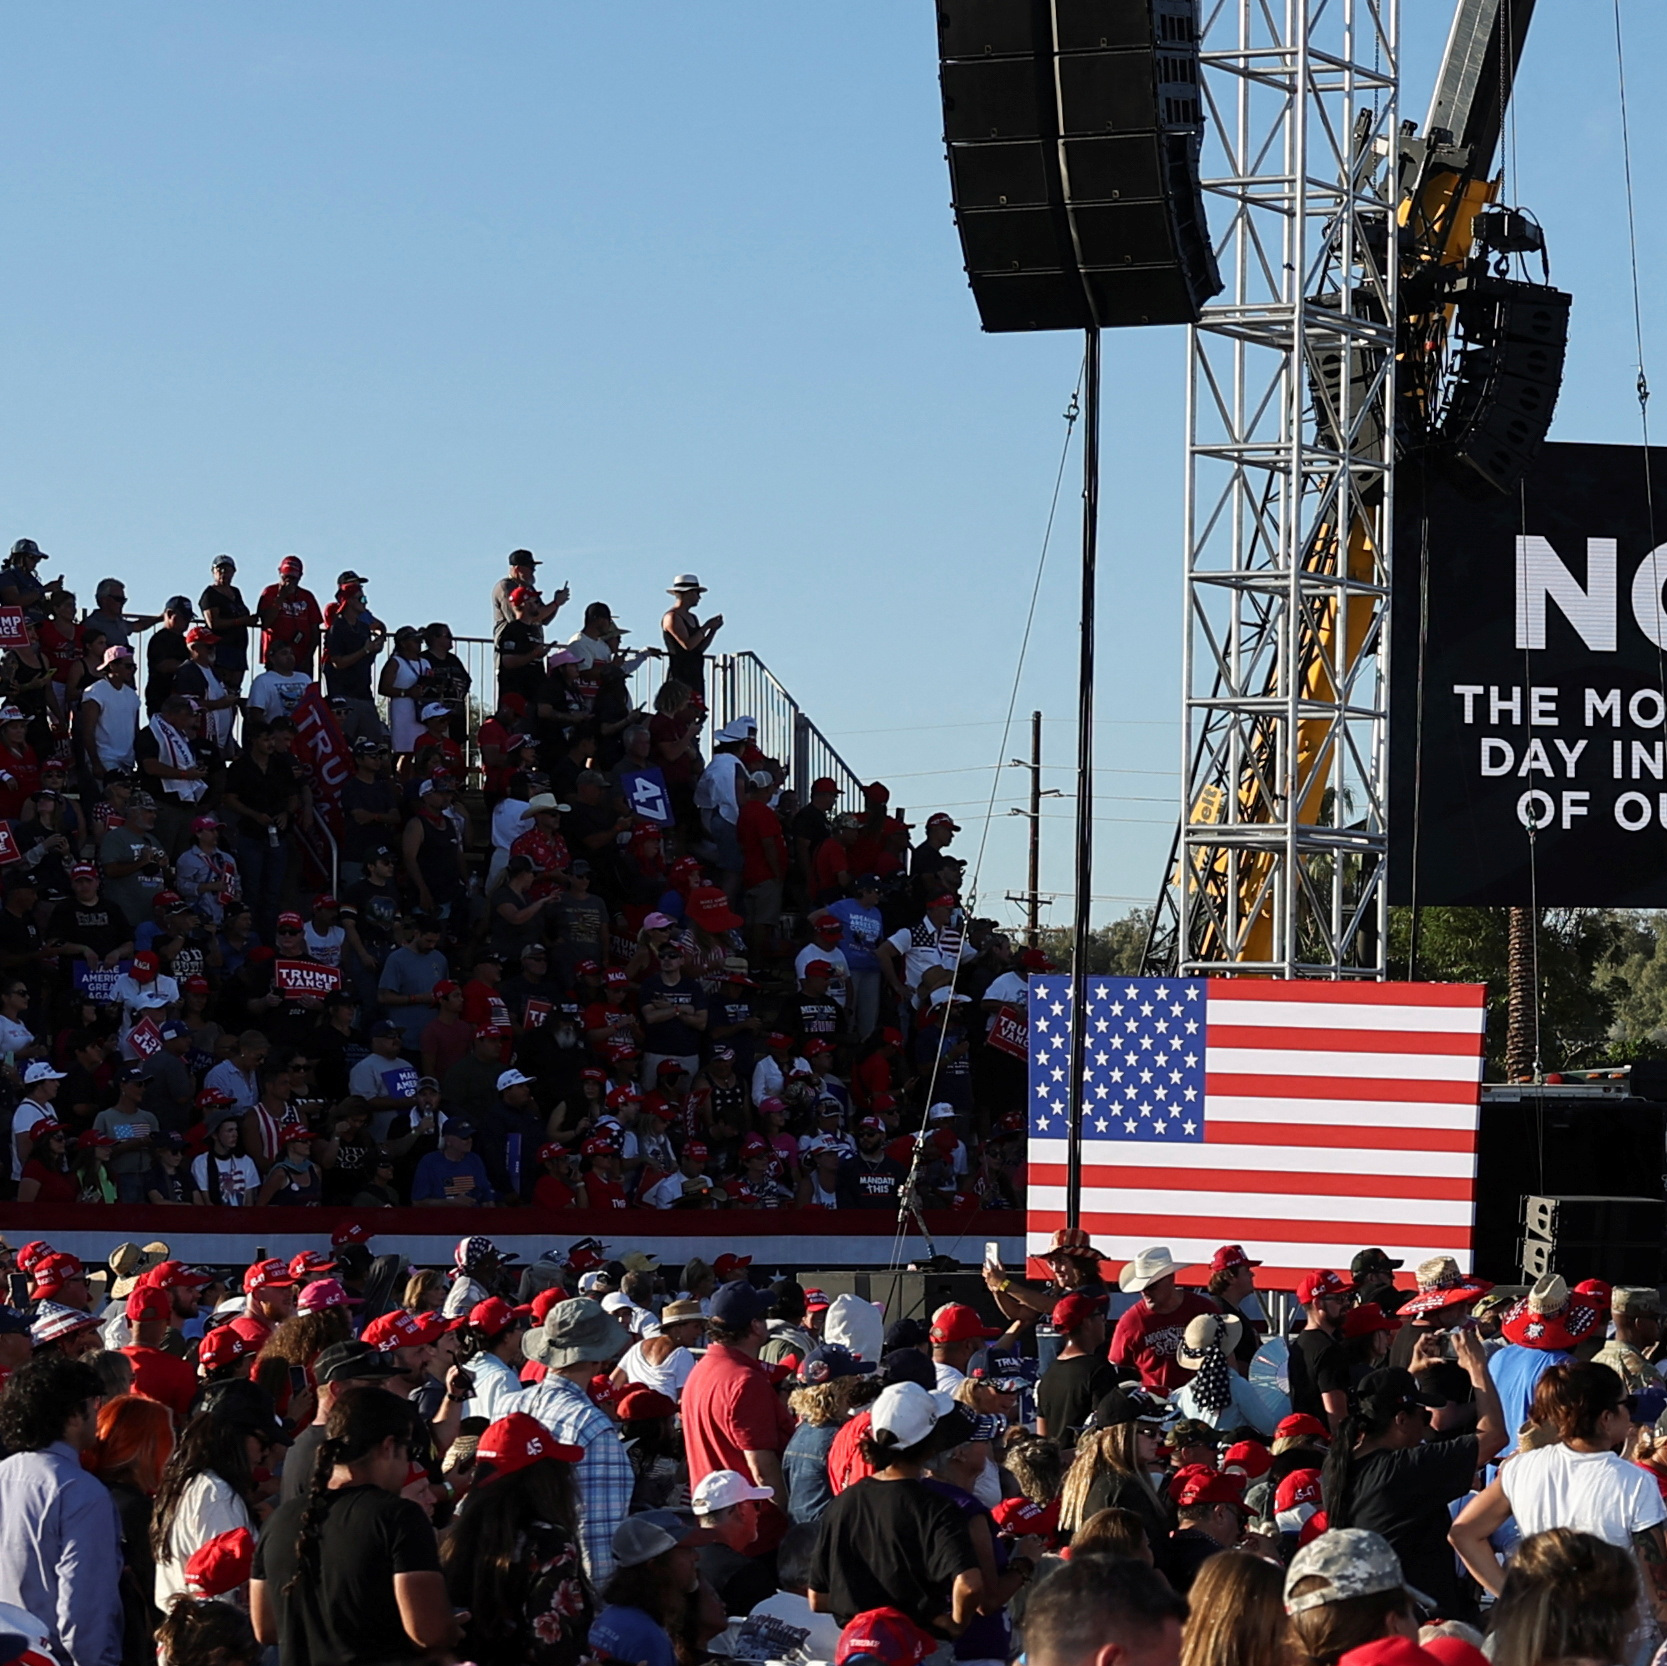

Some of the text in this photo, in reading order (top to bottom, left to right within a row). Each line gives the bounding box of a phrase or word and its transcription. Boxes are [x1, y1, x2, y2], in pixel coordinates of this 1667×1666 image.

[1454, 685, 1558, 727] THE
[1480, 738, 1588, 779] DAY
[1613, 740, 1664, 780] IN
[632, 777, 668, 821] 47
[1516, 790, 1589, 831] OF
[82, 973, 120, 983] AMERIC
[279, 967, 339, 983] TRUMP
[286, 978, 332, 990] VANCE
[867, 1184, 890, 1195] THIS
